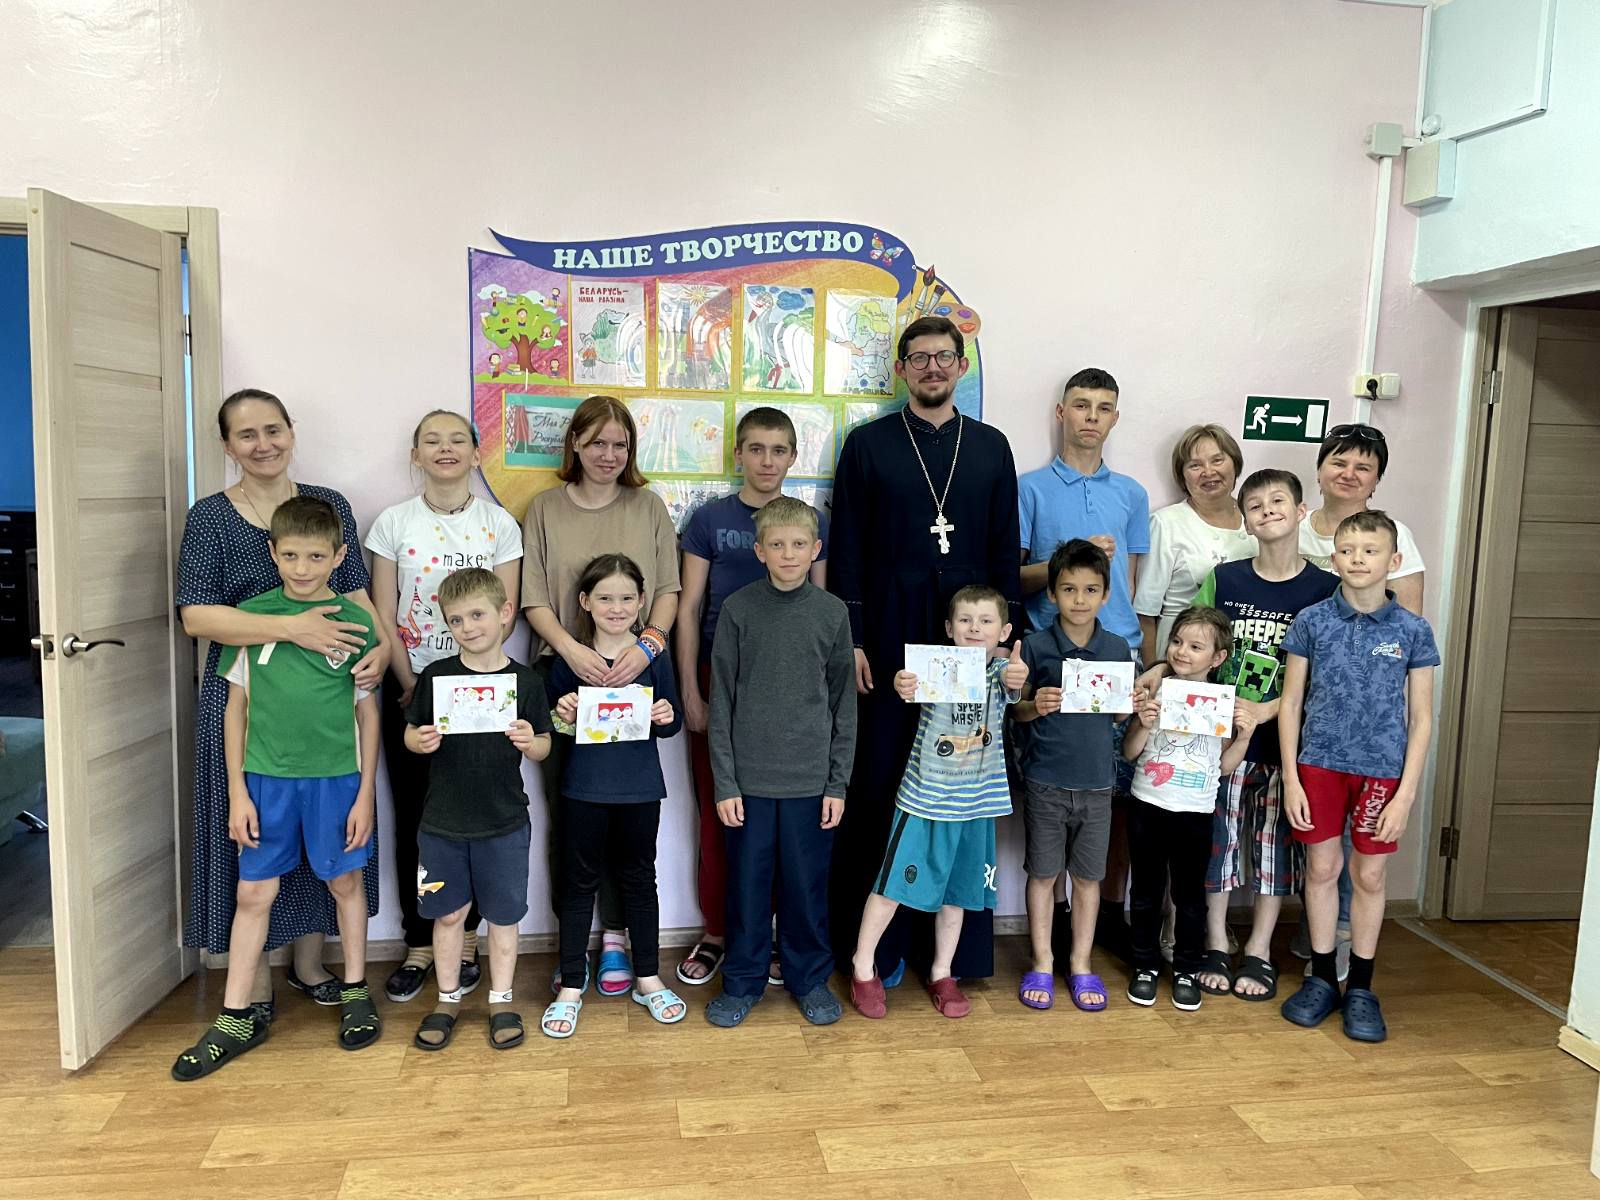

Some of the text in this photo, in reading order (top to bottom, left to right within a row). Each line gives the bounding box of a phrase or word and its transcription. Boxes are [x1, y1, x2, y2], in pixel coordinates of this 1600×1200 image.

[552, 230, 864, 269] НАШЕ ТВОРЧЕСТВО
[443, 552, 483, 569] make
[427, 634, 453, 650] run
